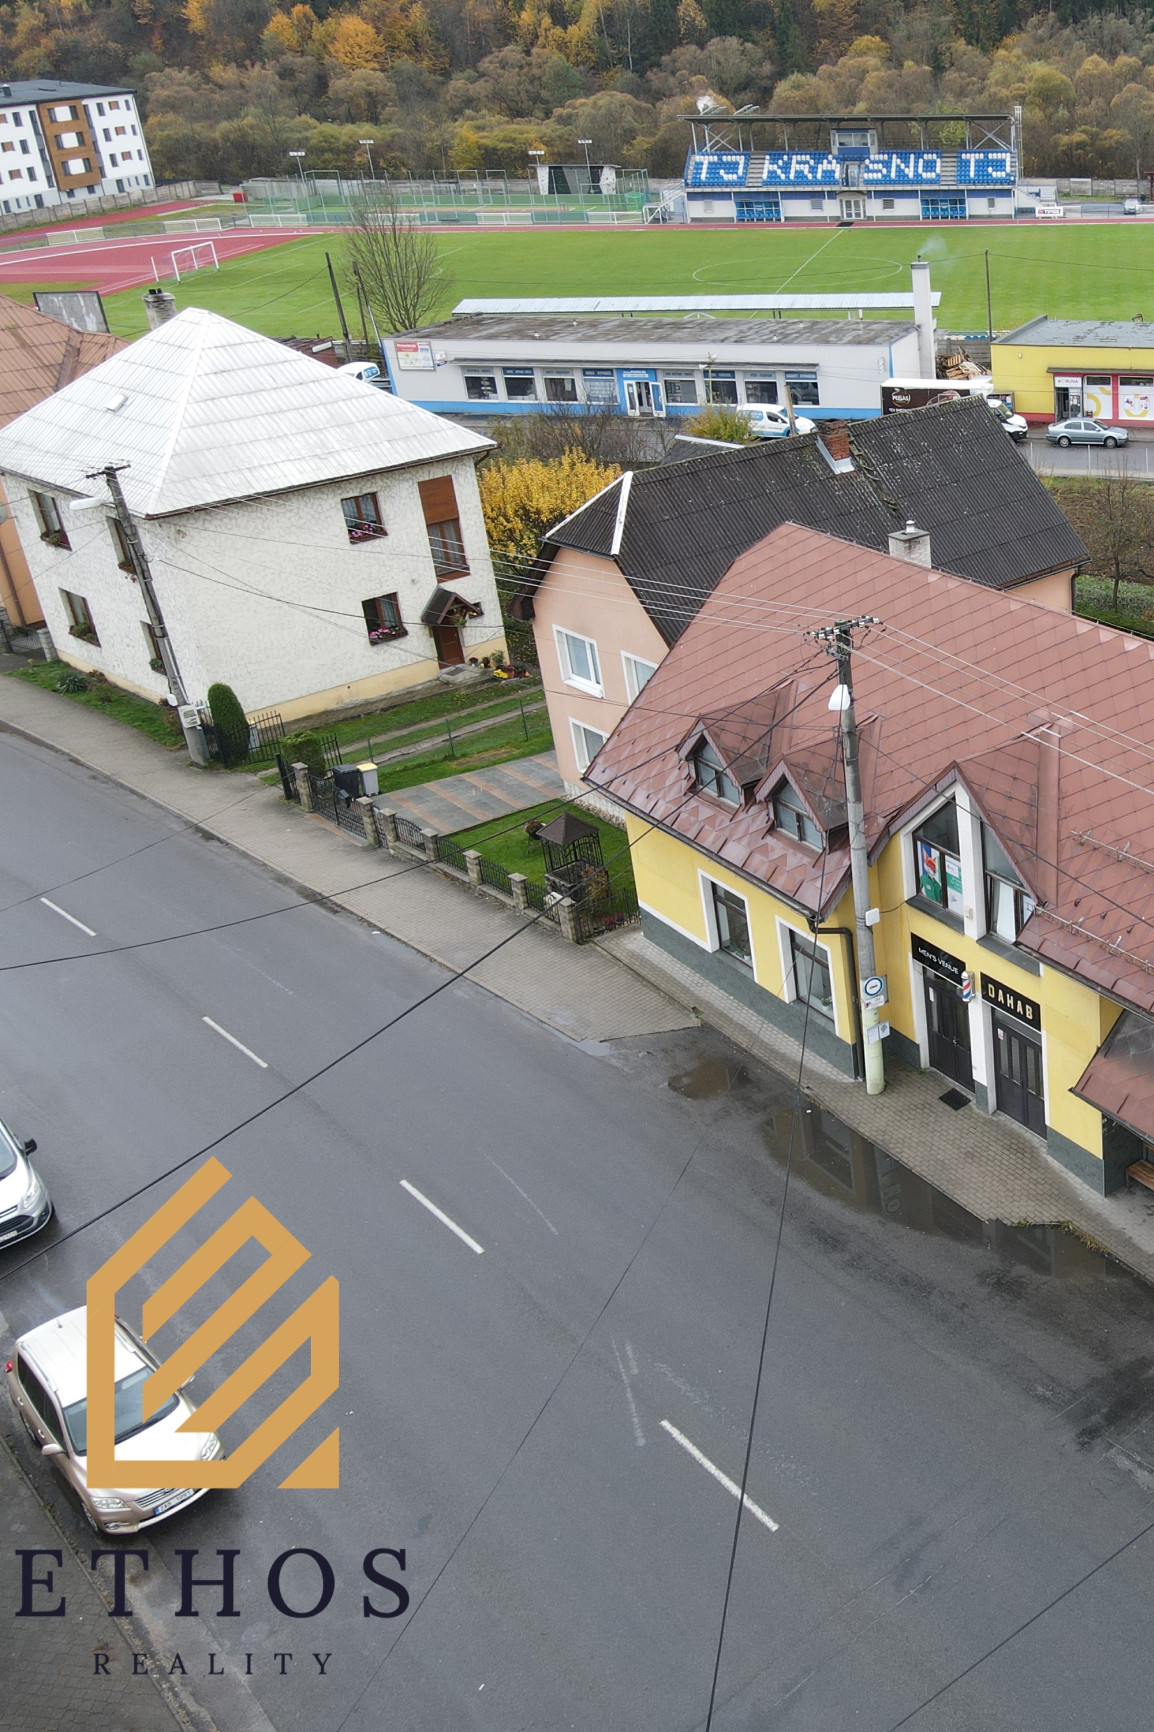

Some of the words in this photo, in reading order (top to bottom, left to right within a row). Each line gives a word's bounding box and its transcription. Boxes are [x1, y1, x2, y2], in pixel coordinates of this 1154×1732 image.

[696, 154, 746, 181] TJ
[957, 152, 1012, 179] TJ
[918, 946, 937, 963] MEN'S
[937, 956, 959, 976] VENUE
[986, 982, 1034, 1020] DAHAB
